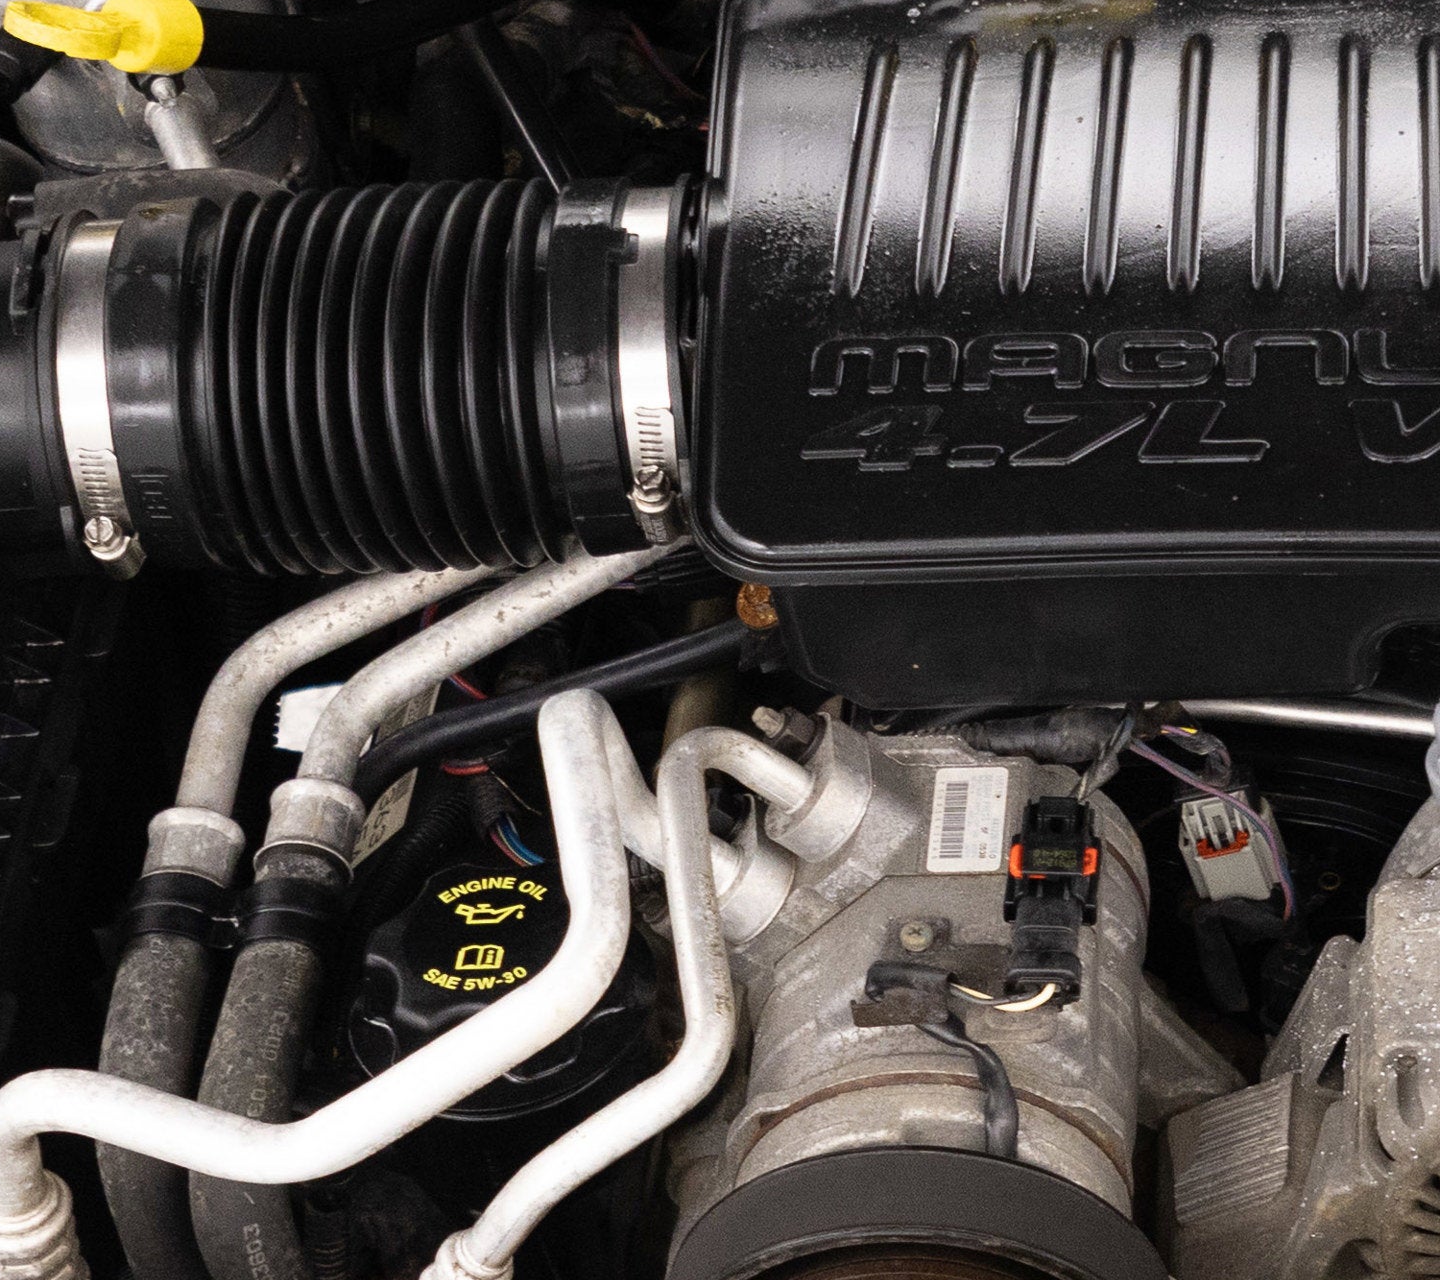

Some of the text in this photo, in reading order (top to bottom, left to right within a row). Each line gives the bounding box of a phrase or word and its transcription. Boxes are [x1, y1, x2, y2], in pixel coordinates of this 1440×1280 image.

[800, 400, 1271, 473] 4.7L
[437, 876, 549, 905] ENGINE OIL
[422, 965, 528, 991] SAE 5W-30
